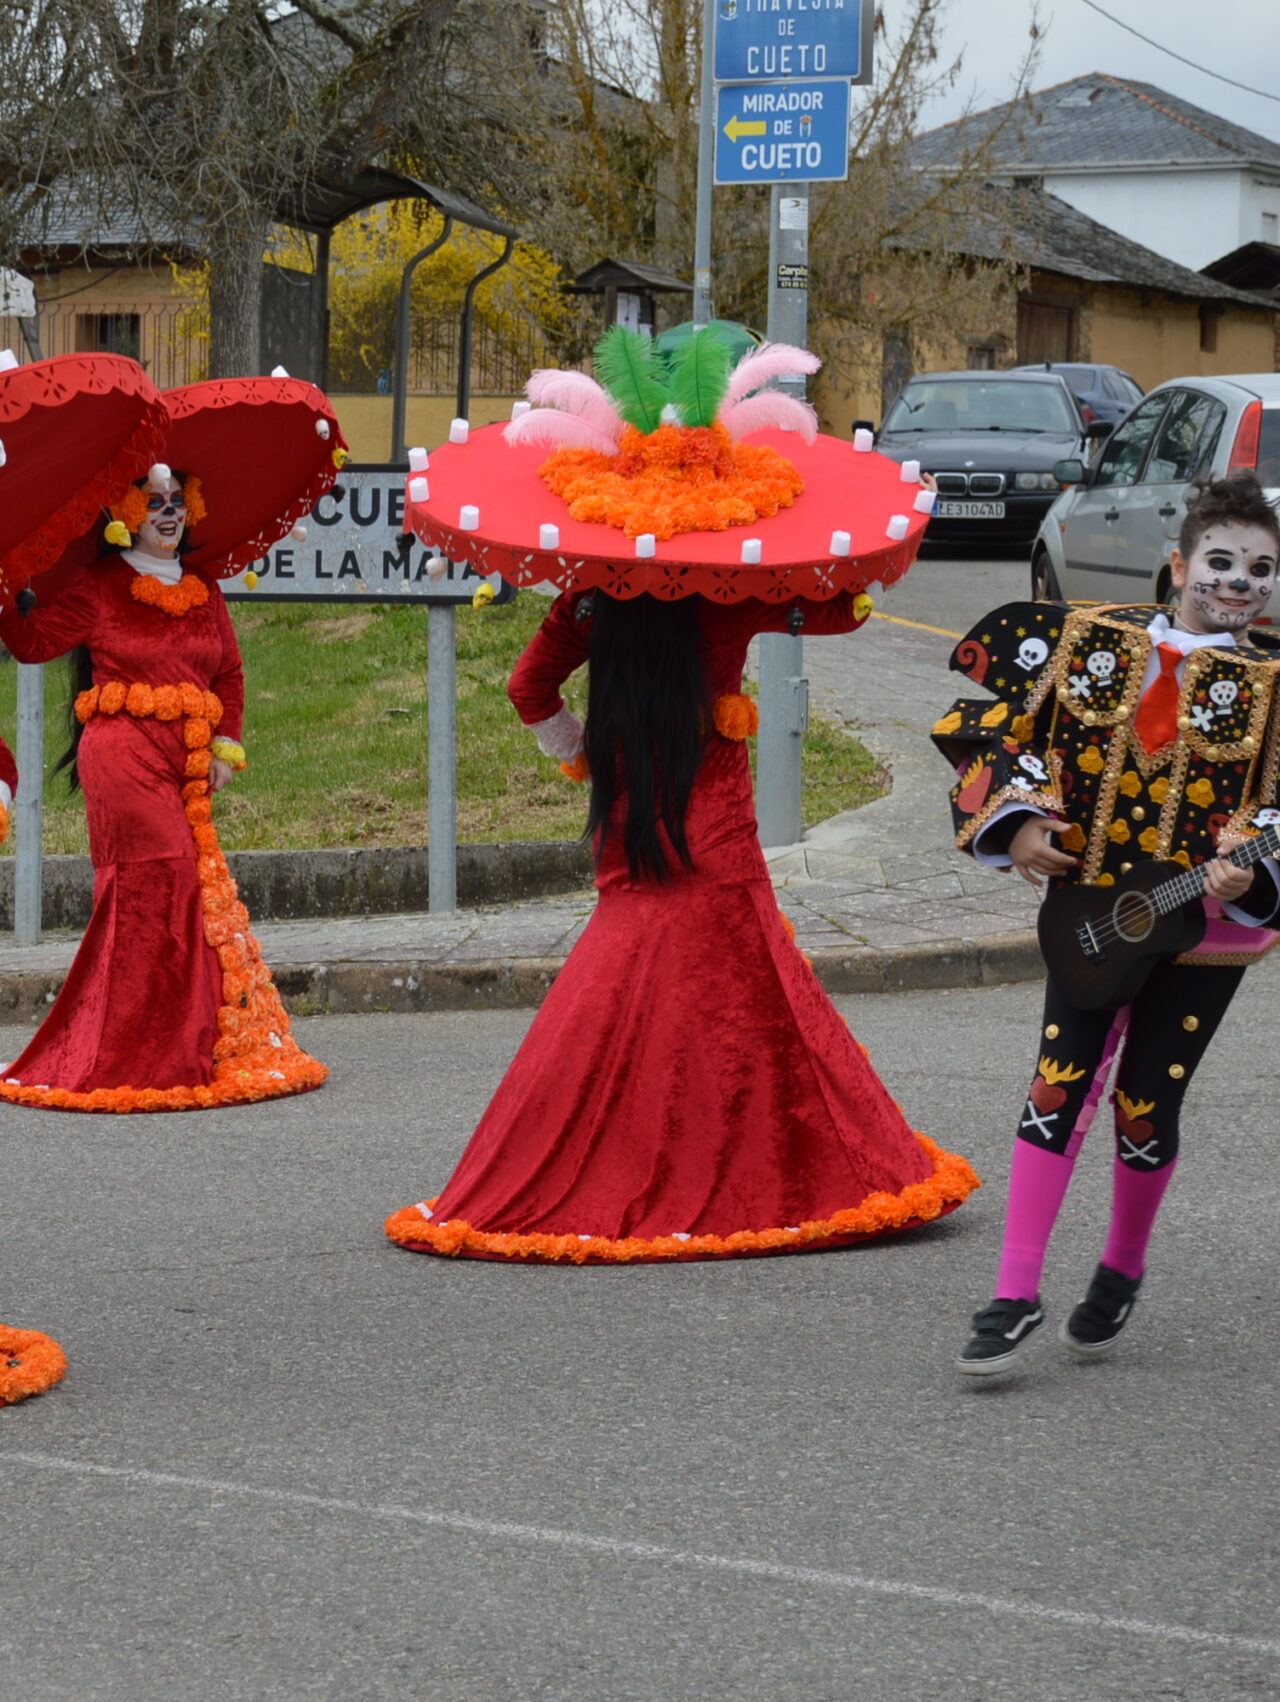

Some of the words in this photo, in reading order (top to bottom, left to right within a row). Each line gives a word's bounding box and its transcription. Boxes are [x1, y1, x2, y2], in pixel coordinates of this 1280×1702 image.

[778, 19, 795, 36] DE
[747, 44, 826, 74] CUETO
[743, 91, 823, 113] MIRADOR
[774, 120, 792, 136] DE
[741, 142, 822, 170] CUETO
[247, 550, 295, 578] DE
[315, 551, 361, 579] LA
